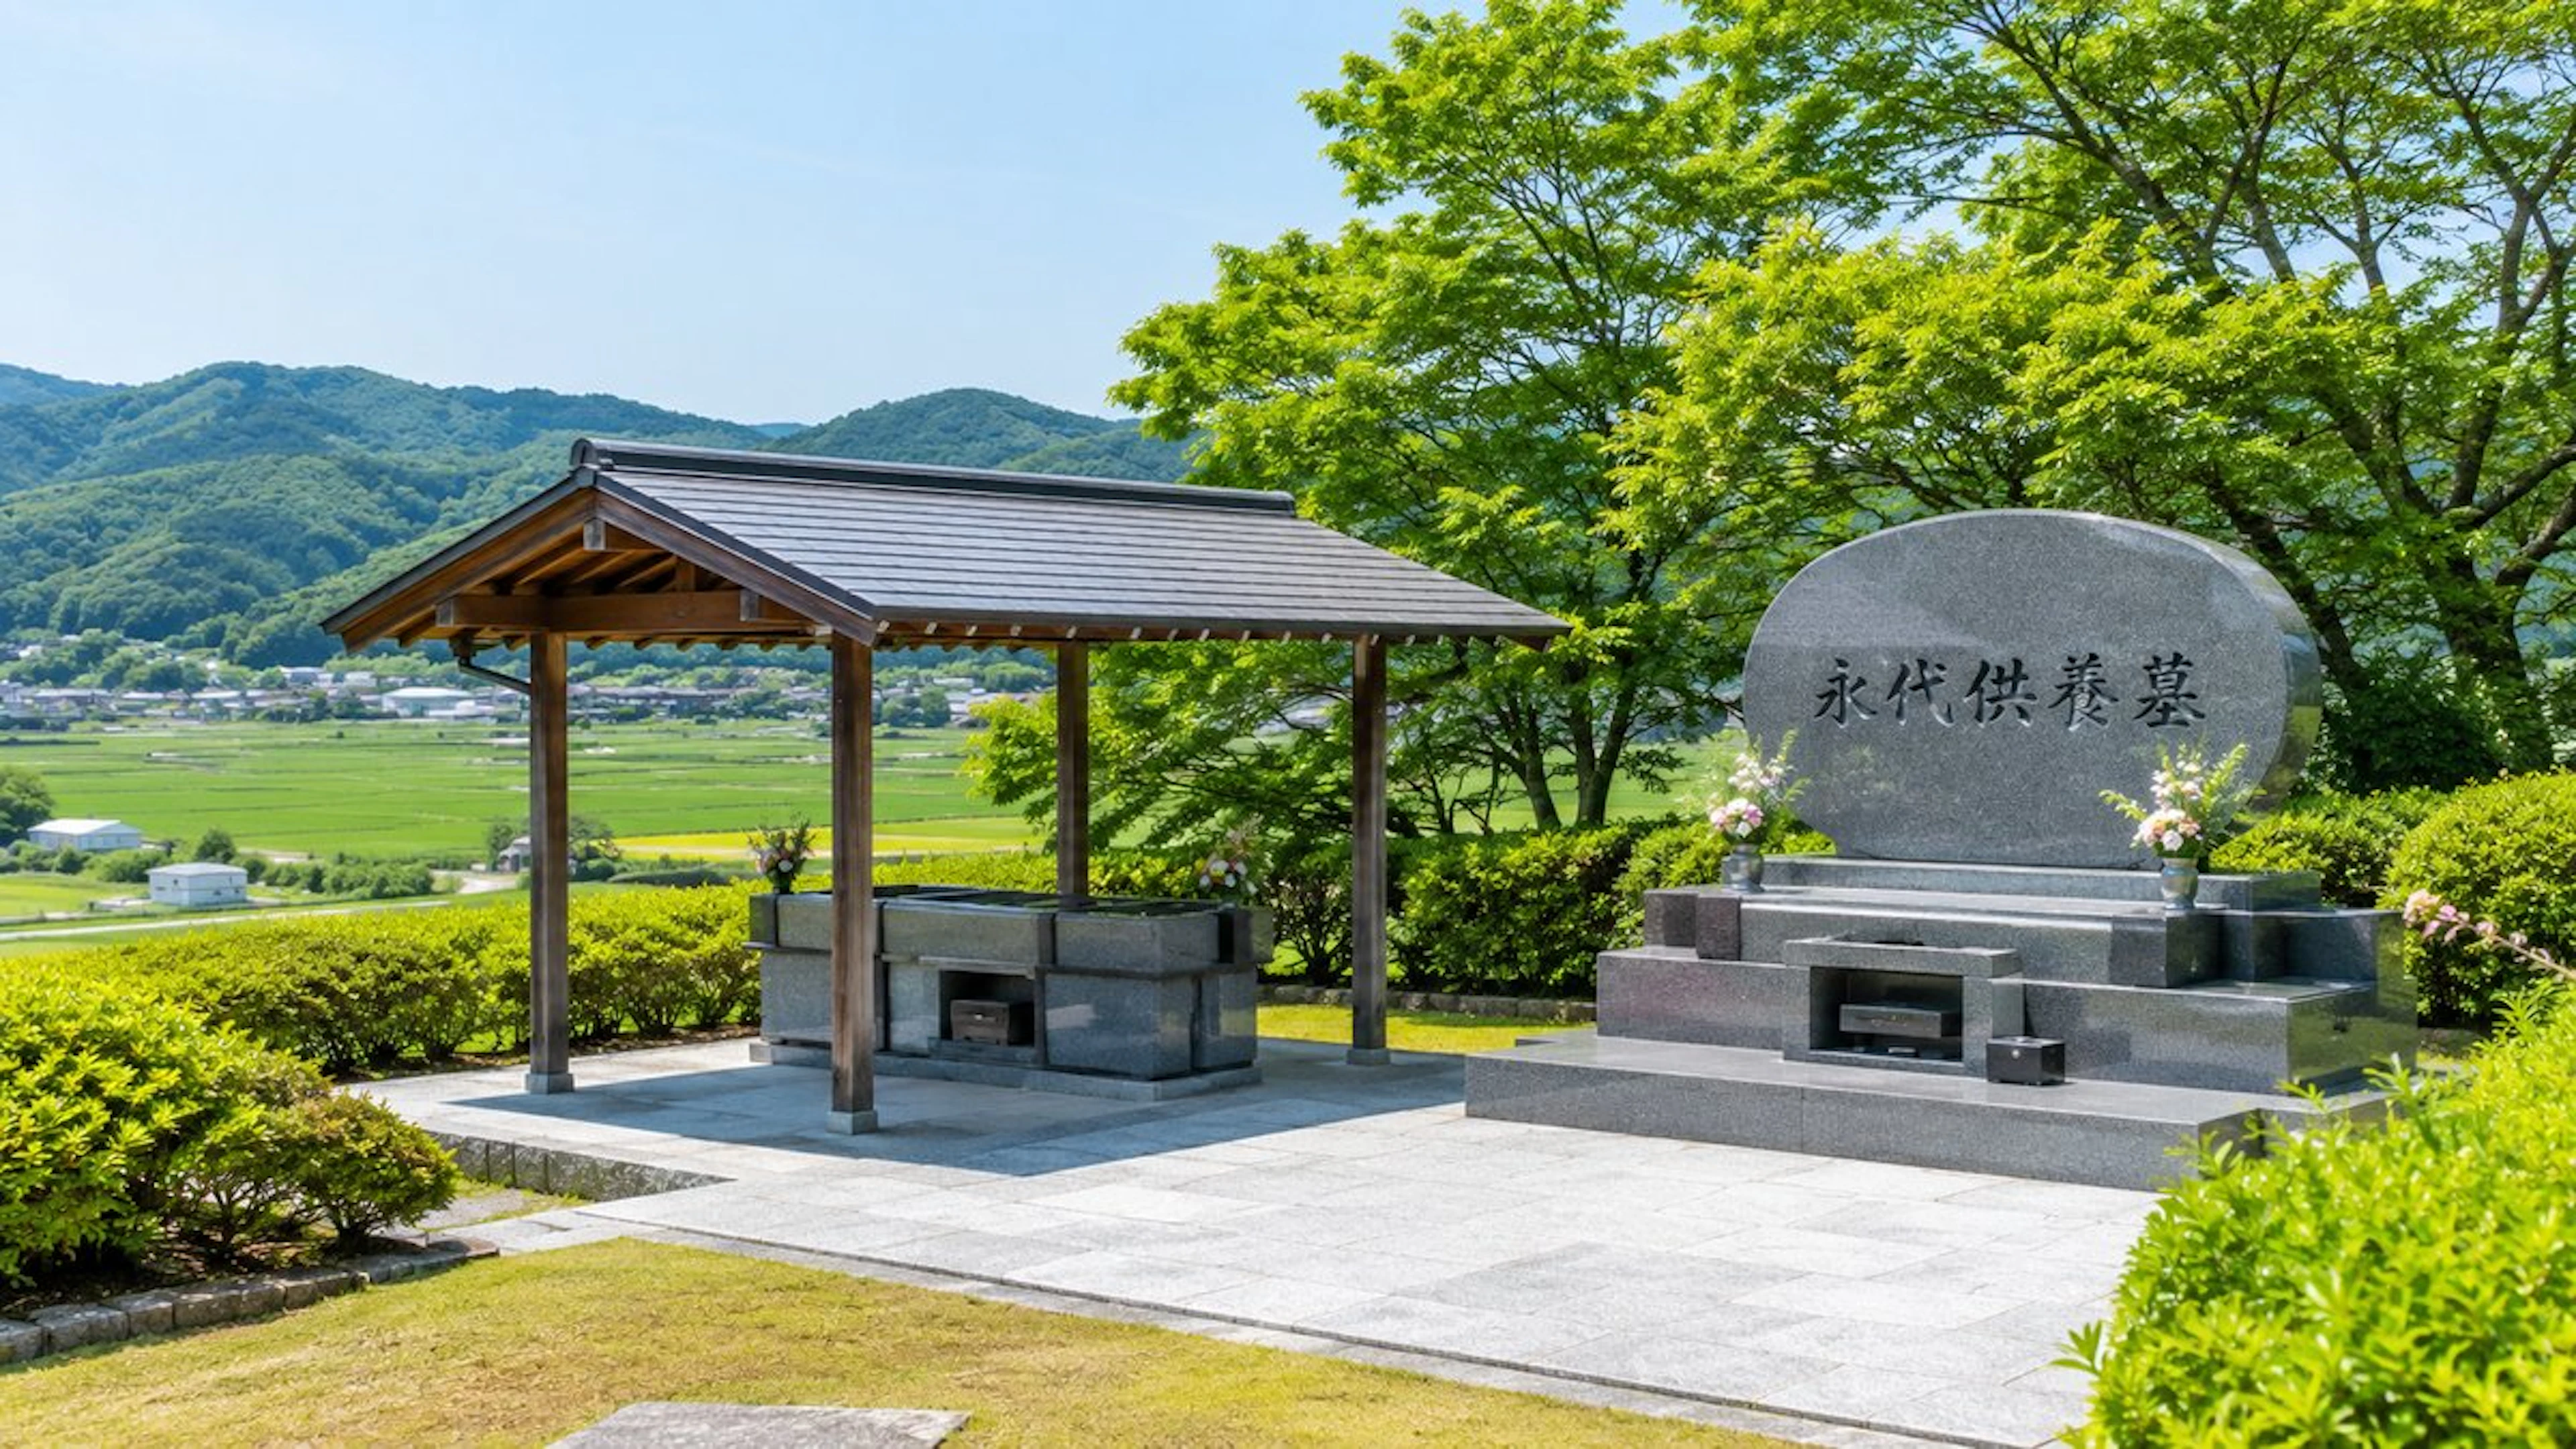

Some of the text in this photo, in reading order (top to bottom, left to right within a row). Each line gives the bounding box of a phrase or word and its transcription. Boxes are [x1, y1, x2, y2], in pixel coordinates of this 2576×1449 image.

[1813, 652, 2206, 730] 永代供養墓
